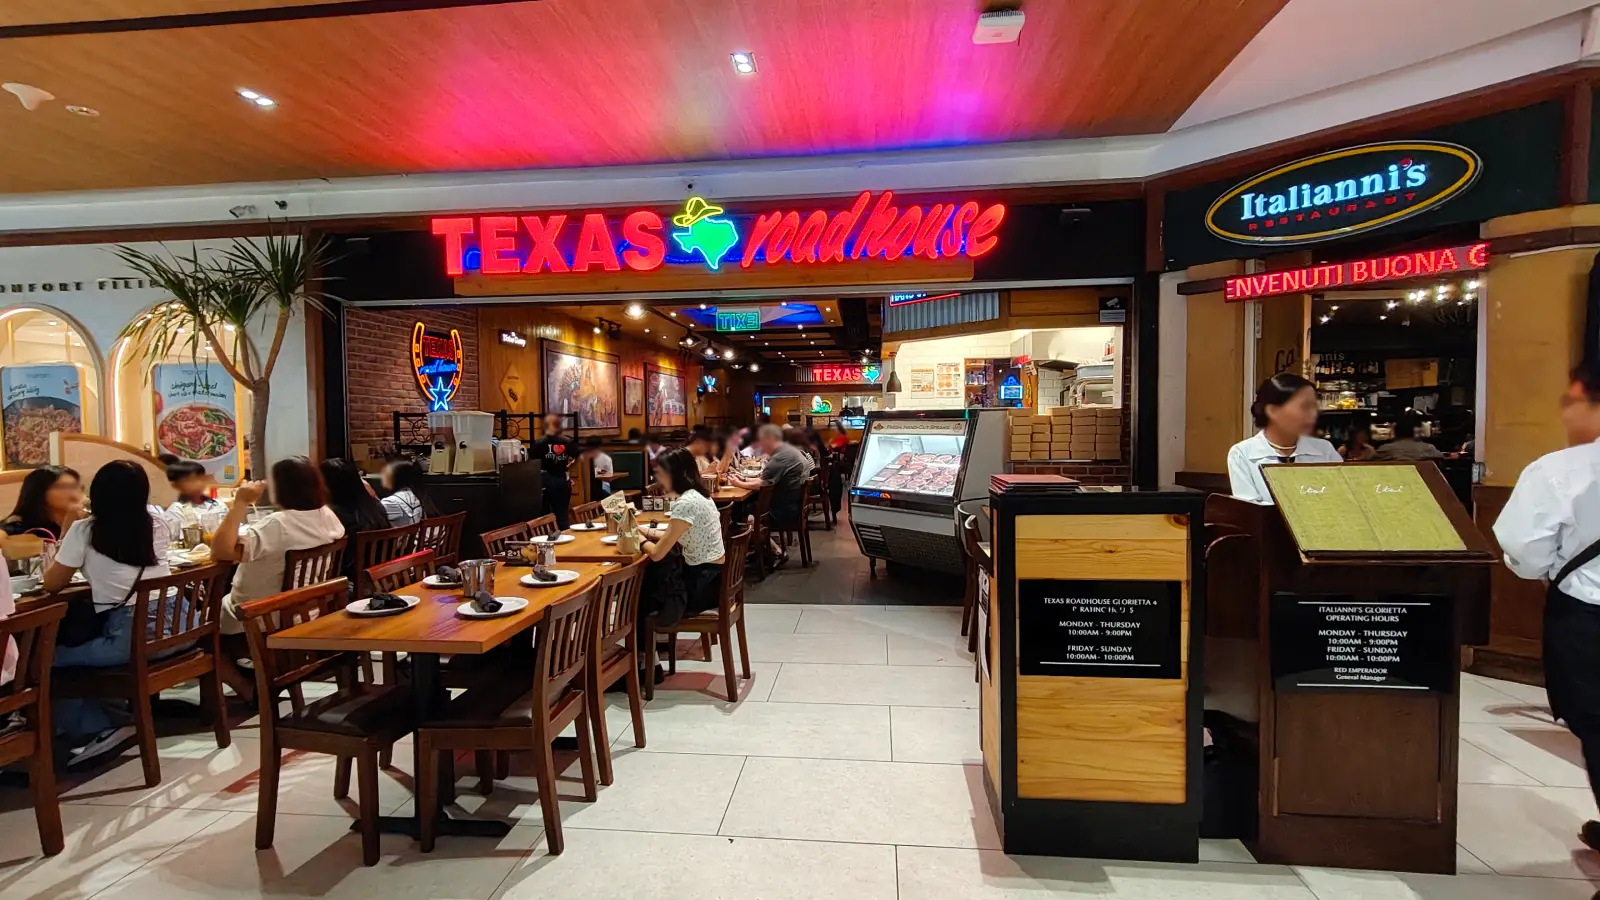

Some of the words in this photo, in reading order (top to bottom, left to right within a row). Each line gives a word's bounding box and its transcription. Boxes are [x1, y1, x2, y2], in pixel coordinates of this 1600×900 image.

[1241, 158, 1427, 220] Italianni's
[431, 211, 666, 275] TEXAS
[741, 190, 1005, 269] roadhouse
[1353, 249, 1457, 282] BUONA
[423, 335, 454, 360] TEXAS
[813, 368, 862, 382] TEXAS
[548, 443, 553, 454] I
